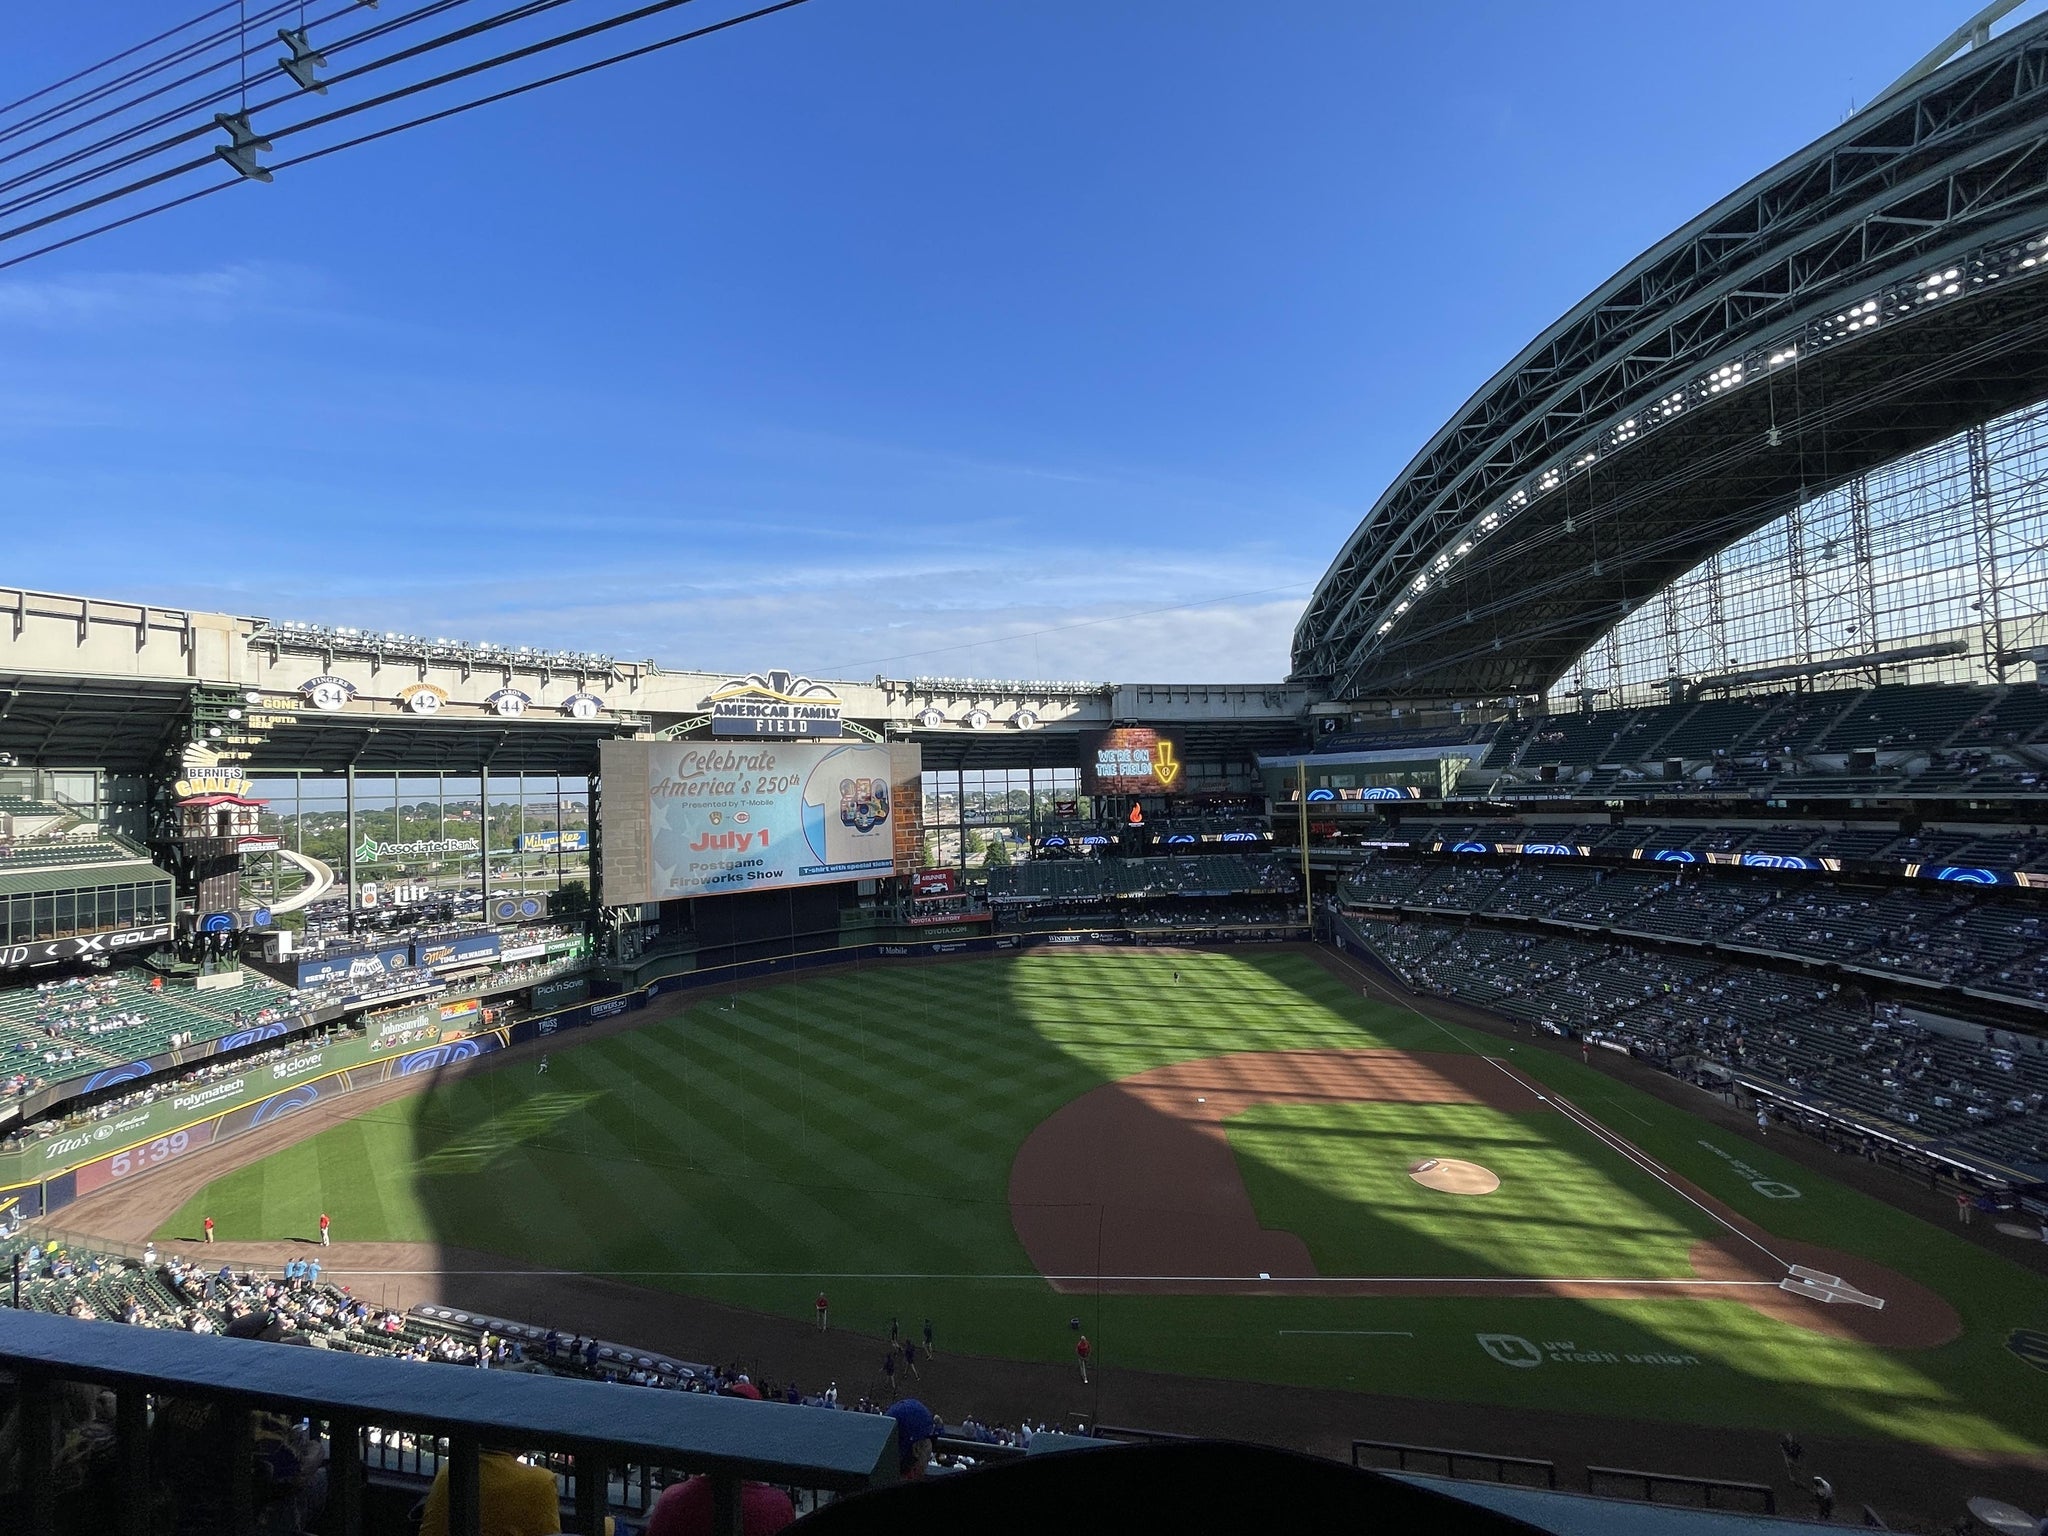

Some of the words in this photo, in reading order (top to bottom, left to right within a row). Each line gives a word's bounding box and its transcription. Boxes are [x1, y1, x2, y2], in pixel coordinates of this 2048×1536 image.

[311, 676, 349, 688] FINGERS
[318, 689, 342, 704] 34
[407, 684, 443, 696] ROBINSON
[499, 689, 522, 698] AARON
[263, 699, 305, 710] GONE!
[415, 695, 436, 709] 42
[500, 700, 520, 713] 44
[713, 703, 789, 718] AMERICAN
[793, 706, 841, 720] FAMILY
[249, 715, 267, 723] GET
[268, 716, 297, 725] OUTTA
[249, 721, 274, 729] HERE
[756, 720, 808, 733] FIELD
[927, 716, 938, 727] 19
[227, 736, 246, 744] GET
[248, 737, 262, 745] UP
[218, 752, 237, 760] GET
[238, 752, 252, 760] UP
[1097, 749, 1131, 762] WE'RE
[1133, 749, 1150, 762] ON
[678, 750, 776, 780] Celebrate
[1095, 764, 1117, 777] THE
[1119, 762, 1152, 776] FIELD!
[188, 768, 243, 778] BERNIE'S
[175, 778, 253, 796] CHALET
[651, 773, 751, 798] America's
[756, 774, 800, 795] 250th
[681, 801, 727, 809] Presented
[728, 800, 739, 808] by
[741, 799, 774, 807] T-Mobile
[378, 840, 450, 855] Associated
[451, 838, 479, 851] Bank
[690, 831, 754, 853] July
[758, 829, 769, 847] 1
[689, 858, 764, 872] Postgame
[803, 865, 830, 874] T-shirt
[846, 862, 872, 871] special
[872, 860, 893, 868] ticket
[670, 873, 744, 888] Fireworks
[747, 869, 784, 881] Show
[394, 885, 430, 906] Lite
[924, 926, 967, 935] TOYOTA.COM
[75, 934, 105, 954] X
[110, 927, 169, 947] GOLF
[422, 946, 456, 966] Miller
[458, 948, 493, 961] MILWAUKEE
[321, 966, 332, 974] GO
[537, 983, 555, 996] Pick
[563, 978, 584, 991] Save
[380, 1015, 430, 1037] Johnsonville
[287, 1053, 323, 1072] clover
[173, 1079, 244, 1110] Polymatech
[120, 1121, 146, 1133] VODKA
[46, 1131, 91, 1159] Tito's
[111, 1131, 189, 1177] 5:39
[1549, 1350, 1620, 1364] credit
[1624, 1351, 1702, 1365] union
